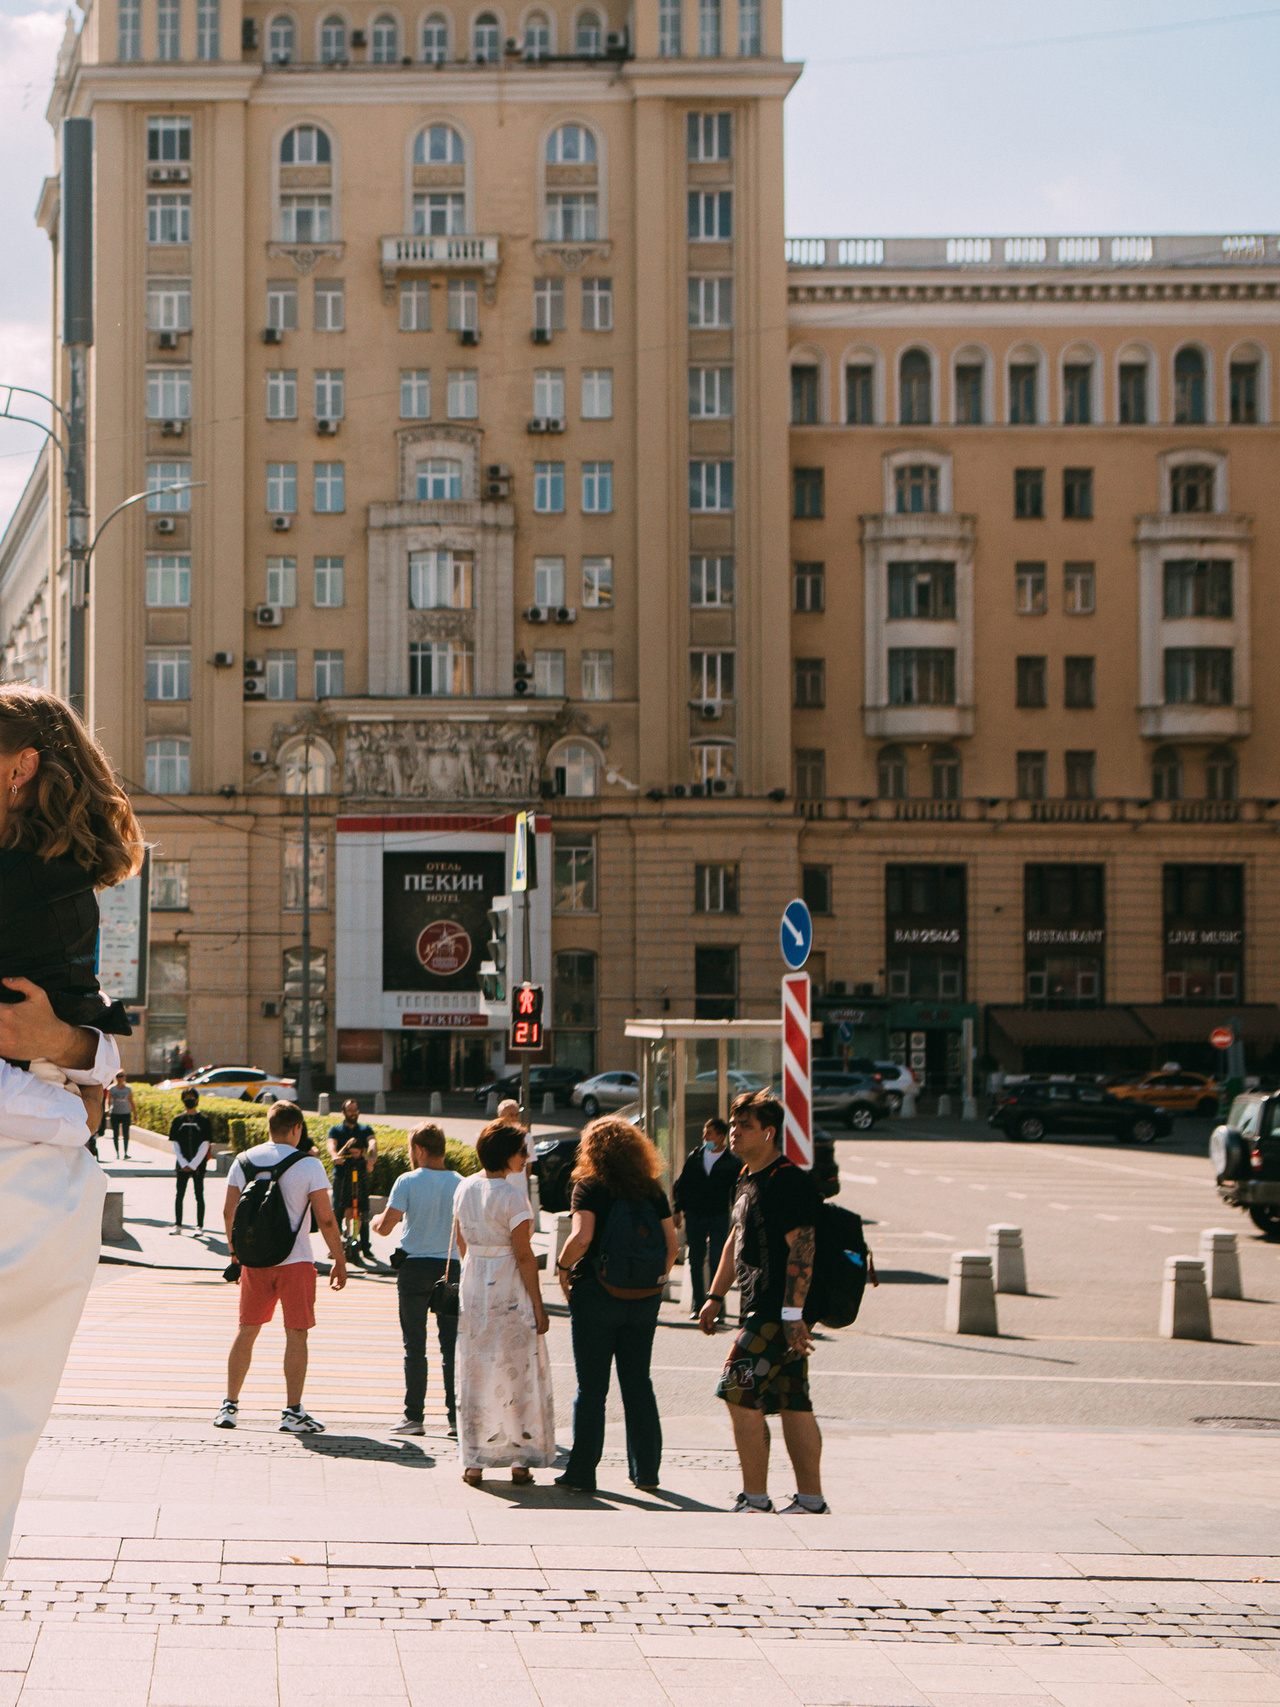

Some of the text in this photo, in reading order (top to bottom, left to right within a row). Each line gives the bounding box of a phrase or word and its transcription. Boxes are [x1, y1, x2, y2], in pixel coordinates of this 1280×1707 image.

[426, 862, 461, 872] ОТЕЛЬ
[404, 874, 484, 892] ПЕКИН
[426, 893, 460, 903] HOTEL
[894, 929, 920, 943] BAR
[1026, 930, 1104, 944] RESTAURANT
[1169, 930, 1243, 944] LIVE MUSIC
[420, 1014, 472, 1027] PEKING
[515, 1022, 538, 1043] 21
